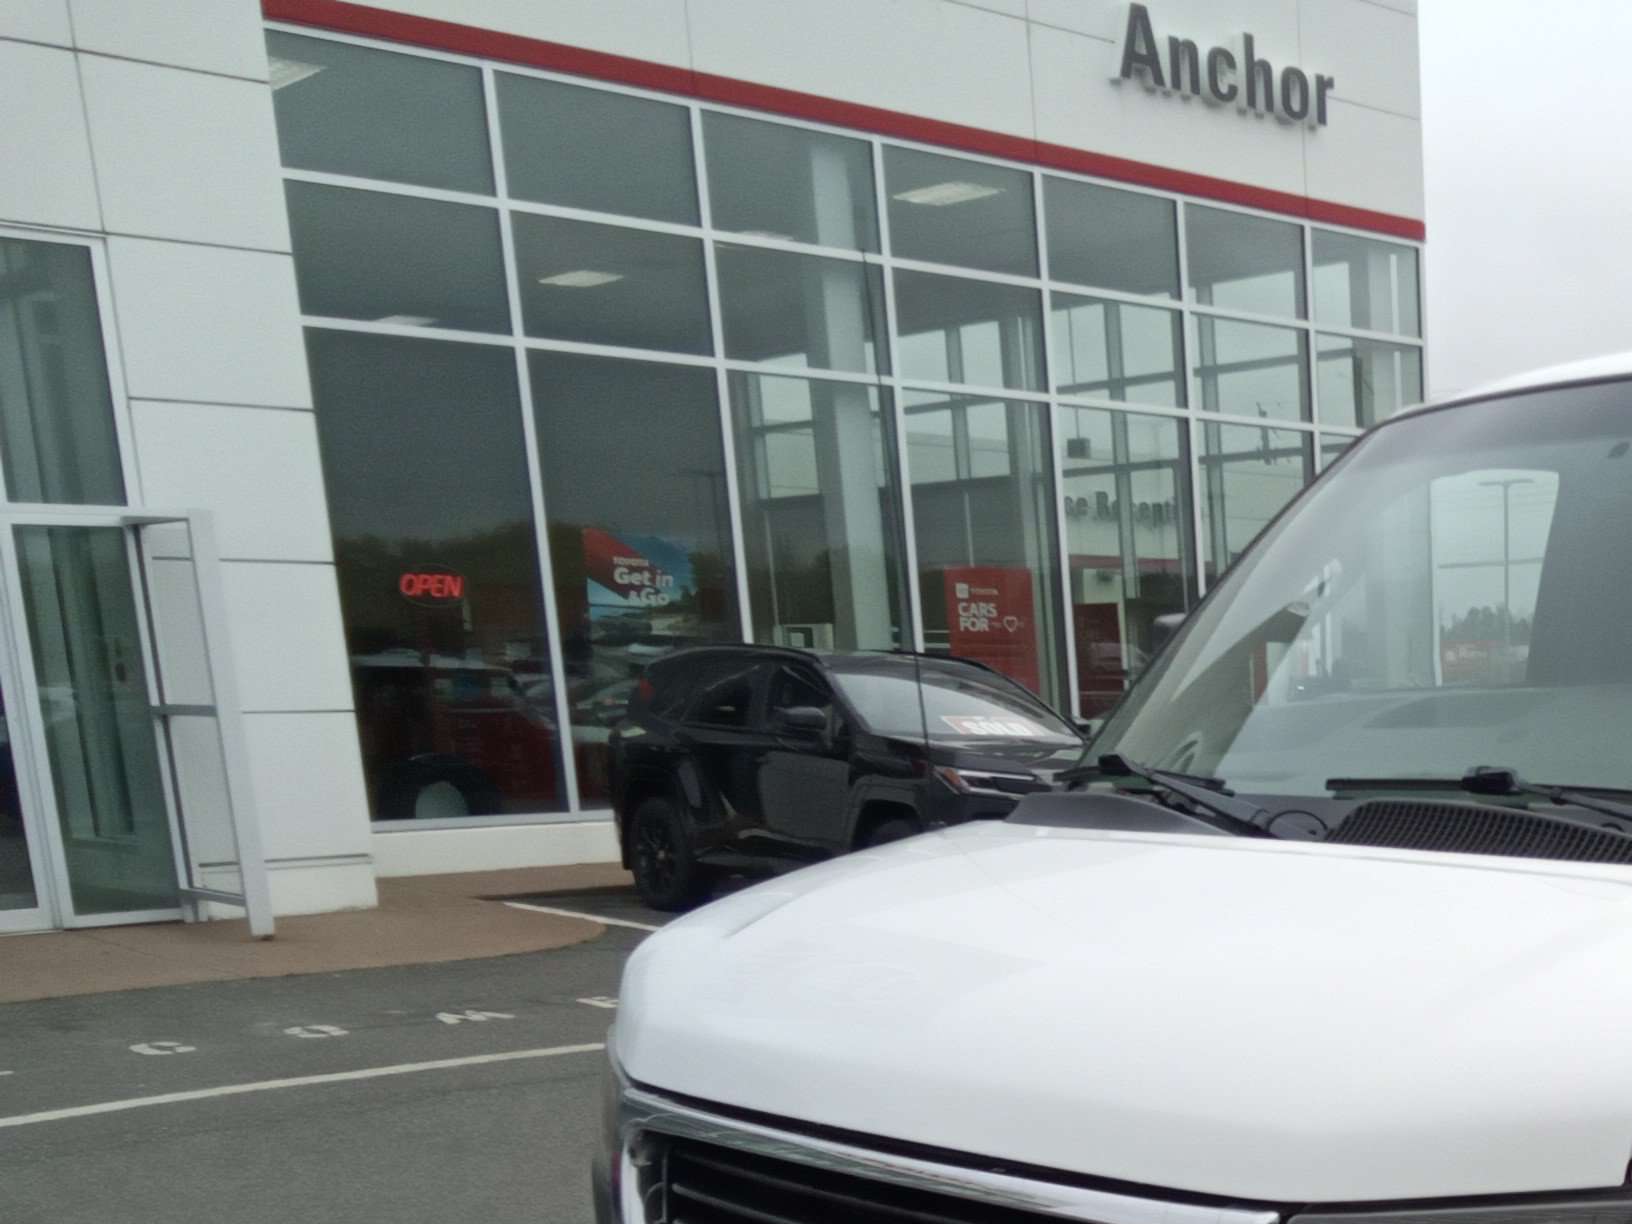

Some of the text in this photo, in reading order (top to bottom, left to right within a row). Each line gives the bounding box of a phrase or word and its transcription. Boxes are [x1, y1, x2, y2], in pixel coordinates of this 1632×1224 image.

[1120, 2, 1334, 125] Anchor
[400, 573, 463, 598] OPEN
[614, 567, 673, 588] Get in
[957, 601, 998, 618] CARS
[959, 616, 990, 632] FOR
